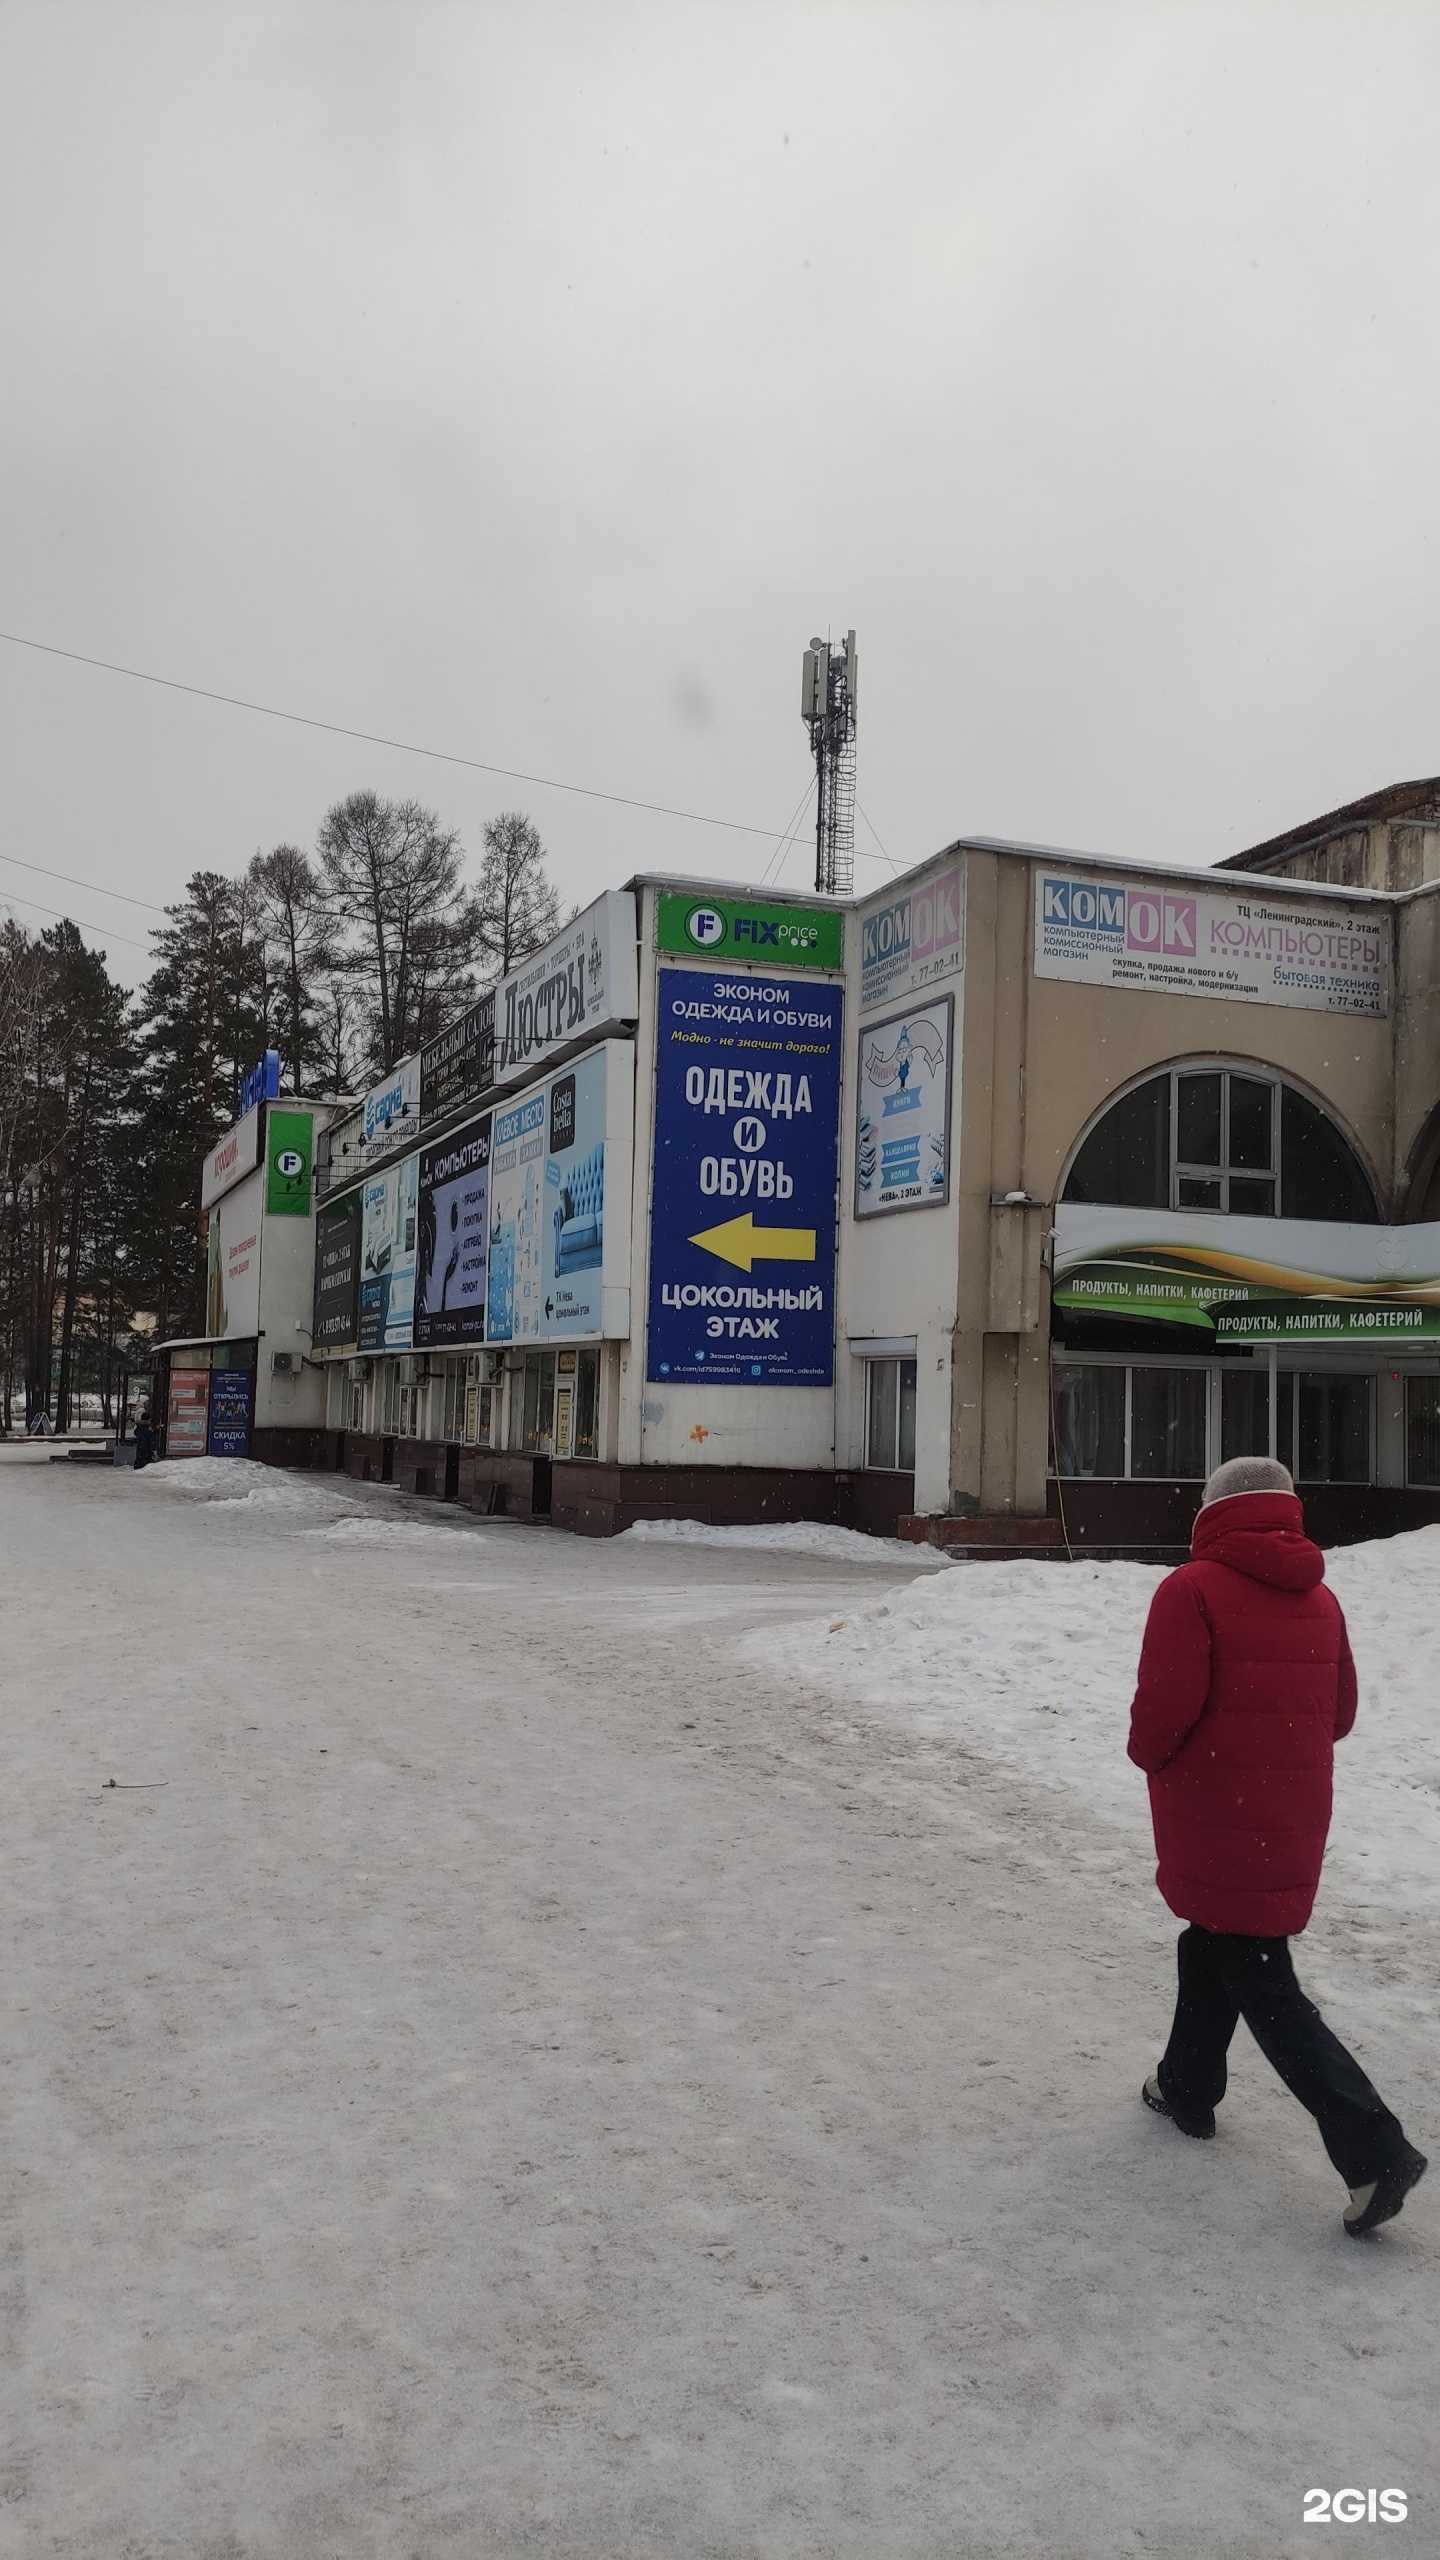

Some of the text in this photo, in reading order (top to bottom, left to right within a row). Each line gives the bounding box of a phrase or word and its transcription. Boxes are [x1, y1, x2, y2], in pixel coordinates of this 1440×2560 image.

[1044, 886, 1194, 948] КОМОК
[1237, 905, 1380, 935] ТЦ «Ленинградский», 2 этаж
[1043, 937, 1124, 955] комиссионный
[1044, 926, 1125, 944] компьютерный
[1210, 919, 1379, 964] КОМПЬЮТЕРЫ
[1043, 947, 1089, 960] магазин
[1112, 958, 1145, 971] скупка,
[1147, 962, 1185, 974] продажа
[1187, 967, 1216, 978] нового
[1225, 969, 1238, 981] б/у
[1112, 968, 1258, 993] ремонт, настройка, модернизация
[1273, 966, 1380, 992] бытовая техника
[714, 983, 789, 1004] ЭКОНОМ
[672, 1000, 832, 1029] ОДЕЖДА И ОБУВИ
[671, 1030, 711, 1044] Модно
[719, 1036, 734, 1047] не
[737, 1038, 782, 1051] значит
[785, 1041, 831, 1055] дорого!
[553, 1090, 571, 1113] Costa
[685, 1066, 812, 1120] ОДЕЖДА
[554, 1110, 571, 1132] bella
[741, 1122, 758, 1147] И
[435, 1134, 490, 1181] КОМПЬЮТЕРЫ
[700, 1156, 794, 1199] ОБУВЬ
[661, 1284, 823, 1311] ЦОКОЛЬНЫЙ
[1072, 1279, 1249, 1301] ПРОДУКТЫ, НАПИТКИ, КАФЕТЕРИЙ
[706, 1316, 779, 1339] ЭТАЖ
[1217, 1310, 1423, 1332] ПРОДУКТЫ, НАПИТКИ, КАФЕТЕРИЙ
[213, 1431, 247, 1441] СКИДКА
